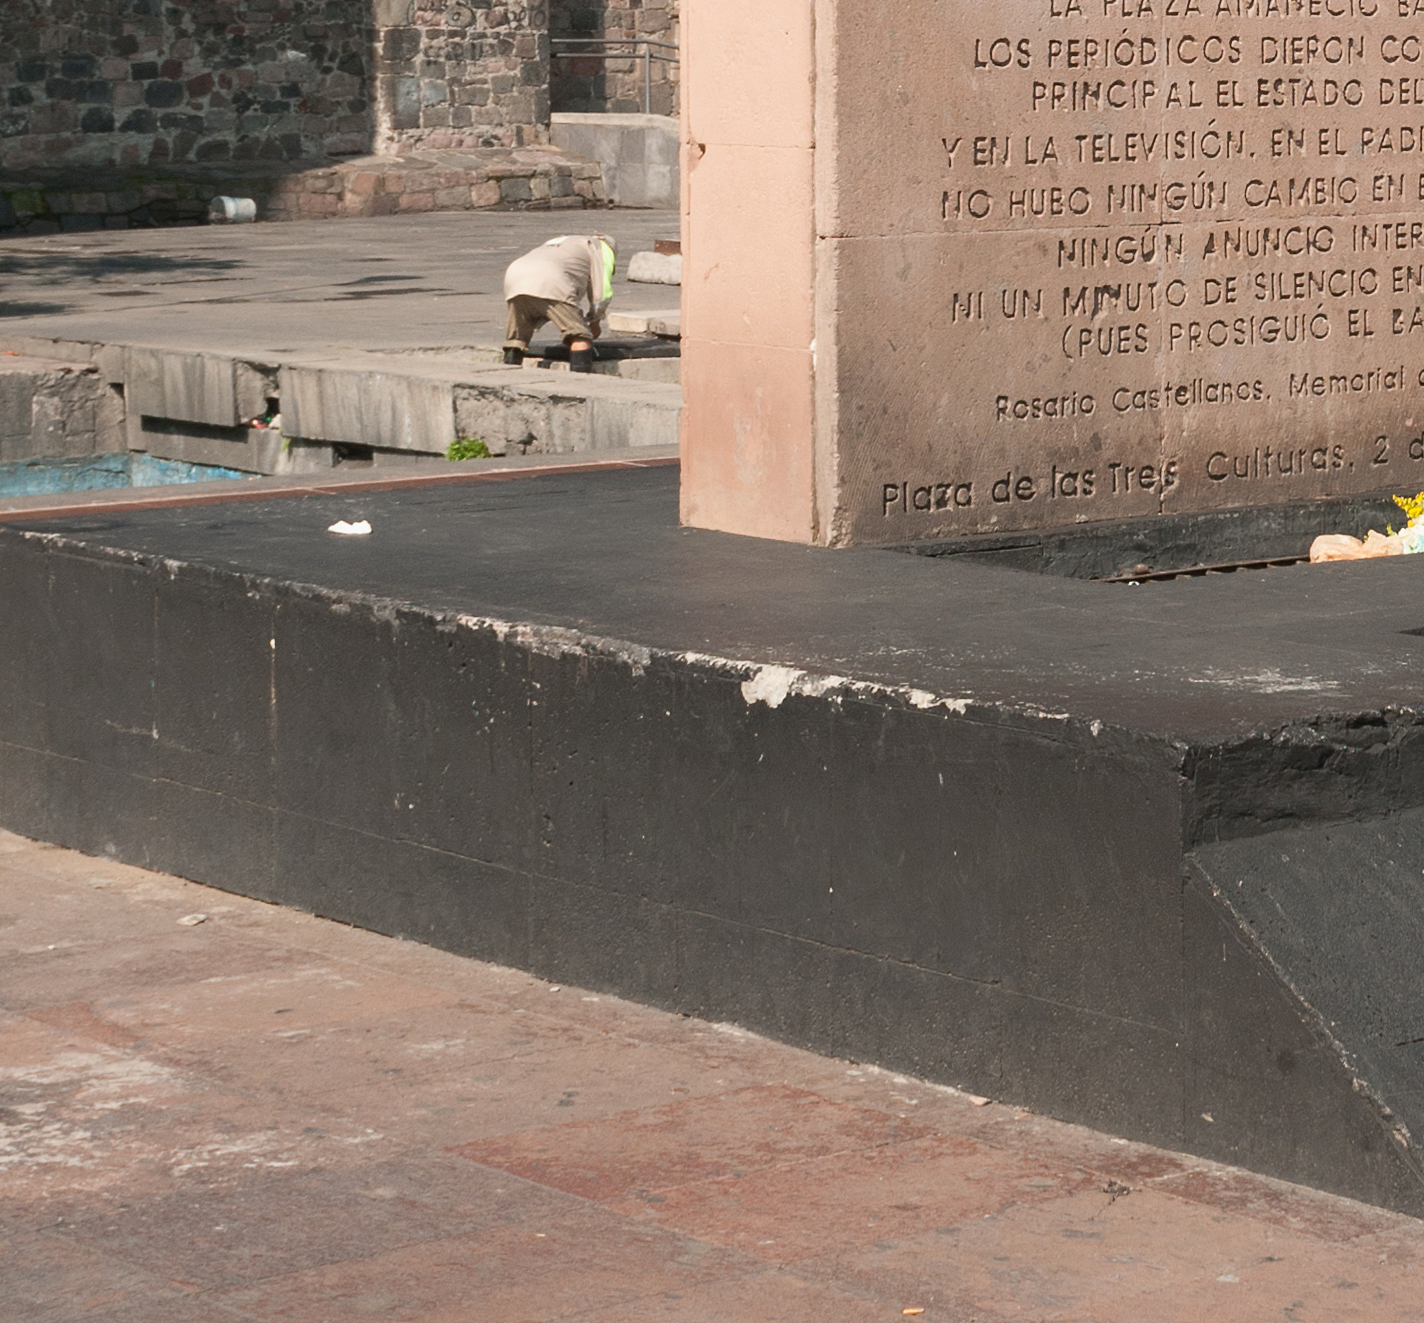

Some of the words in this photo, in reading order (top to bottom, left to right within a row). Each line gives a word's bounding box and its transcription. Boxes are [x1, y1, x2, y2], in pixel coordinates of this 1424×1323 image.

[973, 38, 1031, 69] LOS
[1046, 27, 1242, 68] PERIÓDICOS
[1260, 35, 1364, 65] DIERON
[1032, 78, 1203, 111] PRINCIPAL
[1216, 78, 1245, 108] EL
[1256, 75, 1364, 107] ESTADO
[1378, 74, 1424, 104] DEL
[940, 137, 963, 168] Y
[972, 136, 1009, 167] EN
[1024, 134, 1059, 165] LA
[1270, 126, 1306, 157] EN
[1317, 125, 1347, 155] EL
[941, 188, 994, 223] NO
[1008, 184, 1091, 220] HUBO
[1107, 169, 1227, 215] NINGÚN
[1244, 174, 1358, 209] CAMBIO
[1371, 172, 1403, 203] EN
[1057, 227, 1185, 270] NINGÚN
[951, 291, 984, 324] NI
[1001, 287, 1044, 321] UN
[1203, 275, 1238, 307] DE
[1254, 266, 1379, 304] SILENCIO
[1391, 263, 1423, 295] EN
[1062, 322, 1149, 361] (PUES
[1347, 307, 1375, 339] EL
[994, 386, 1096, 426] Rosario
[1288, 361, 1405, 399] Memorial
[881, 474, 974, 519] Plaza
[1050, 461, 1096, 501] las
[1372, 432, 1390, 467] 2
